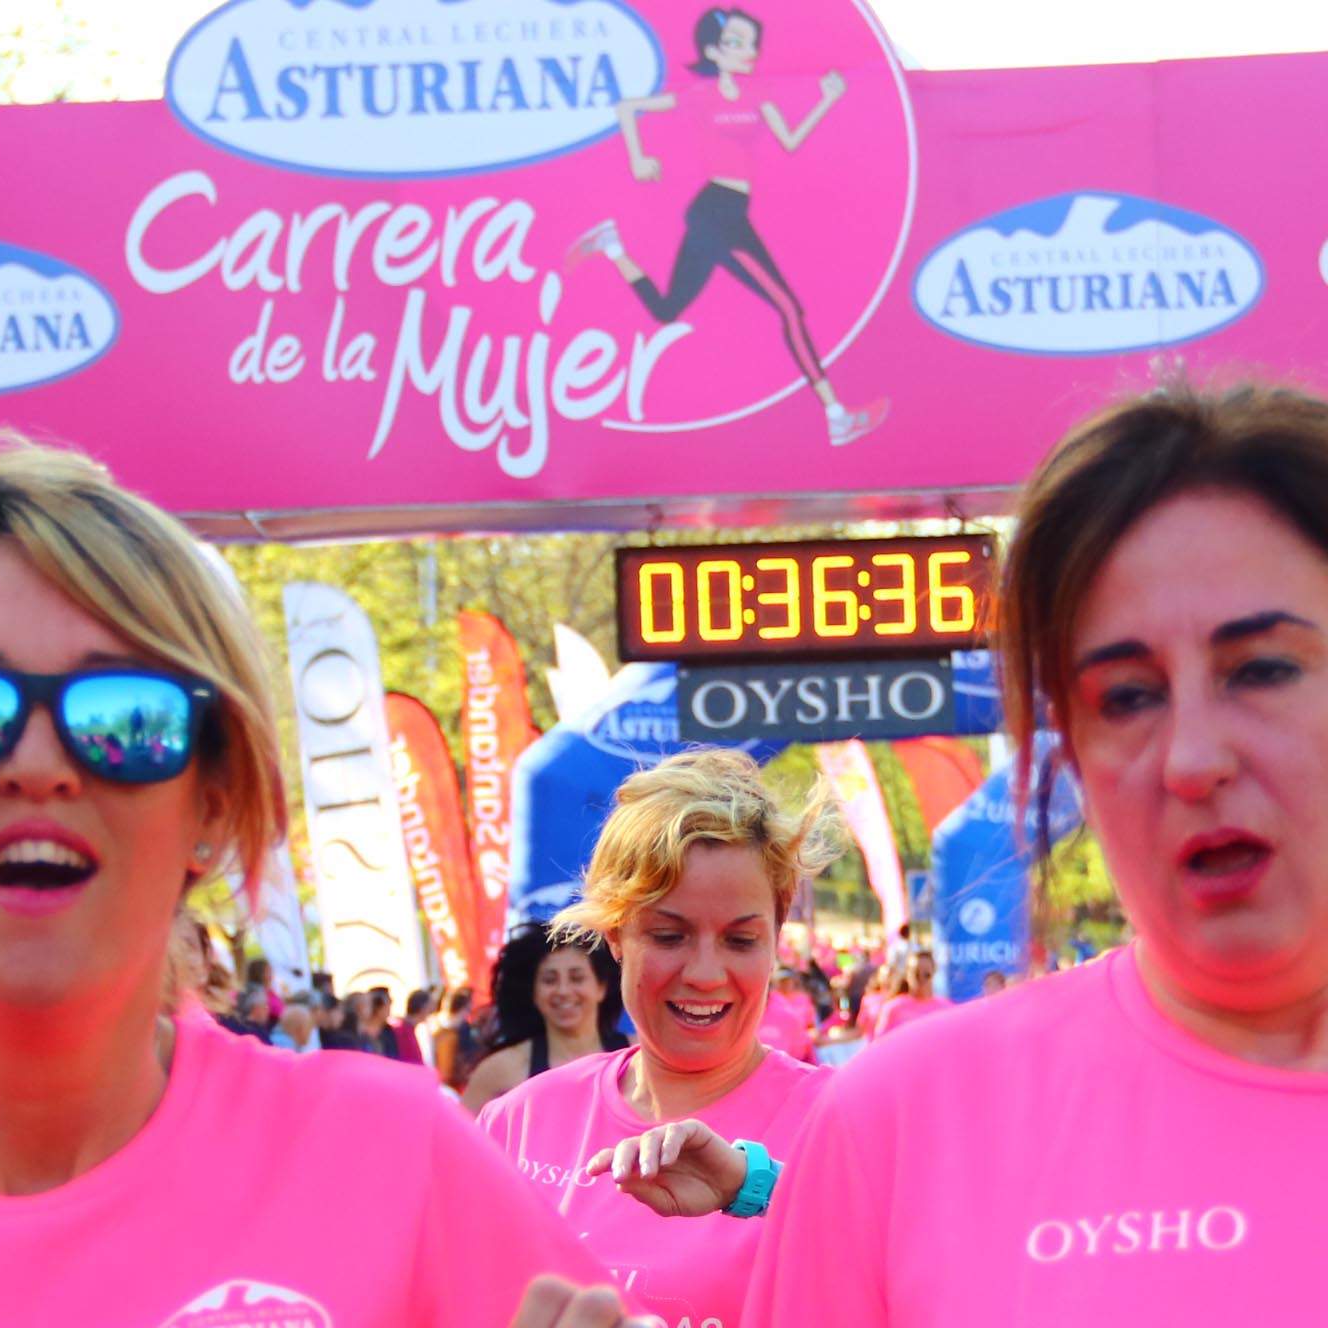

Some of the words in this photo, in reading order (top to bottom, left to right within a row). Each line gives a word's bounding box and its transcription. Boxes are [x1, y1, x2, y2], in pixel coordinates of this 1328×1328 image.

[277, 24, 445, 50] CENTRAL
[451, 19, 610, 43] LECHERA
[205, 36, 625, 123] ASTURIANA
[125, 170, 538, 294] Carrera
[939, 258, 1239, 320] ASTURIANA
[228, 300, 304, 385] de
[322, 297, 377, 383] la
[367, 270, 696, 479] Mujer
[638, 550, 976, 644] 00:36:36
[690, 670, 947, 731] OYSHO
[1027, 1205, 1247, 1263] OYSHO
